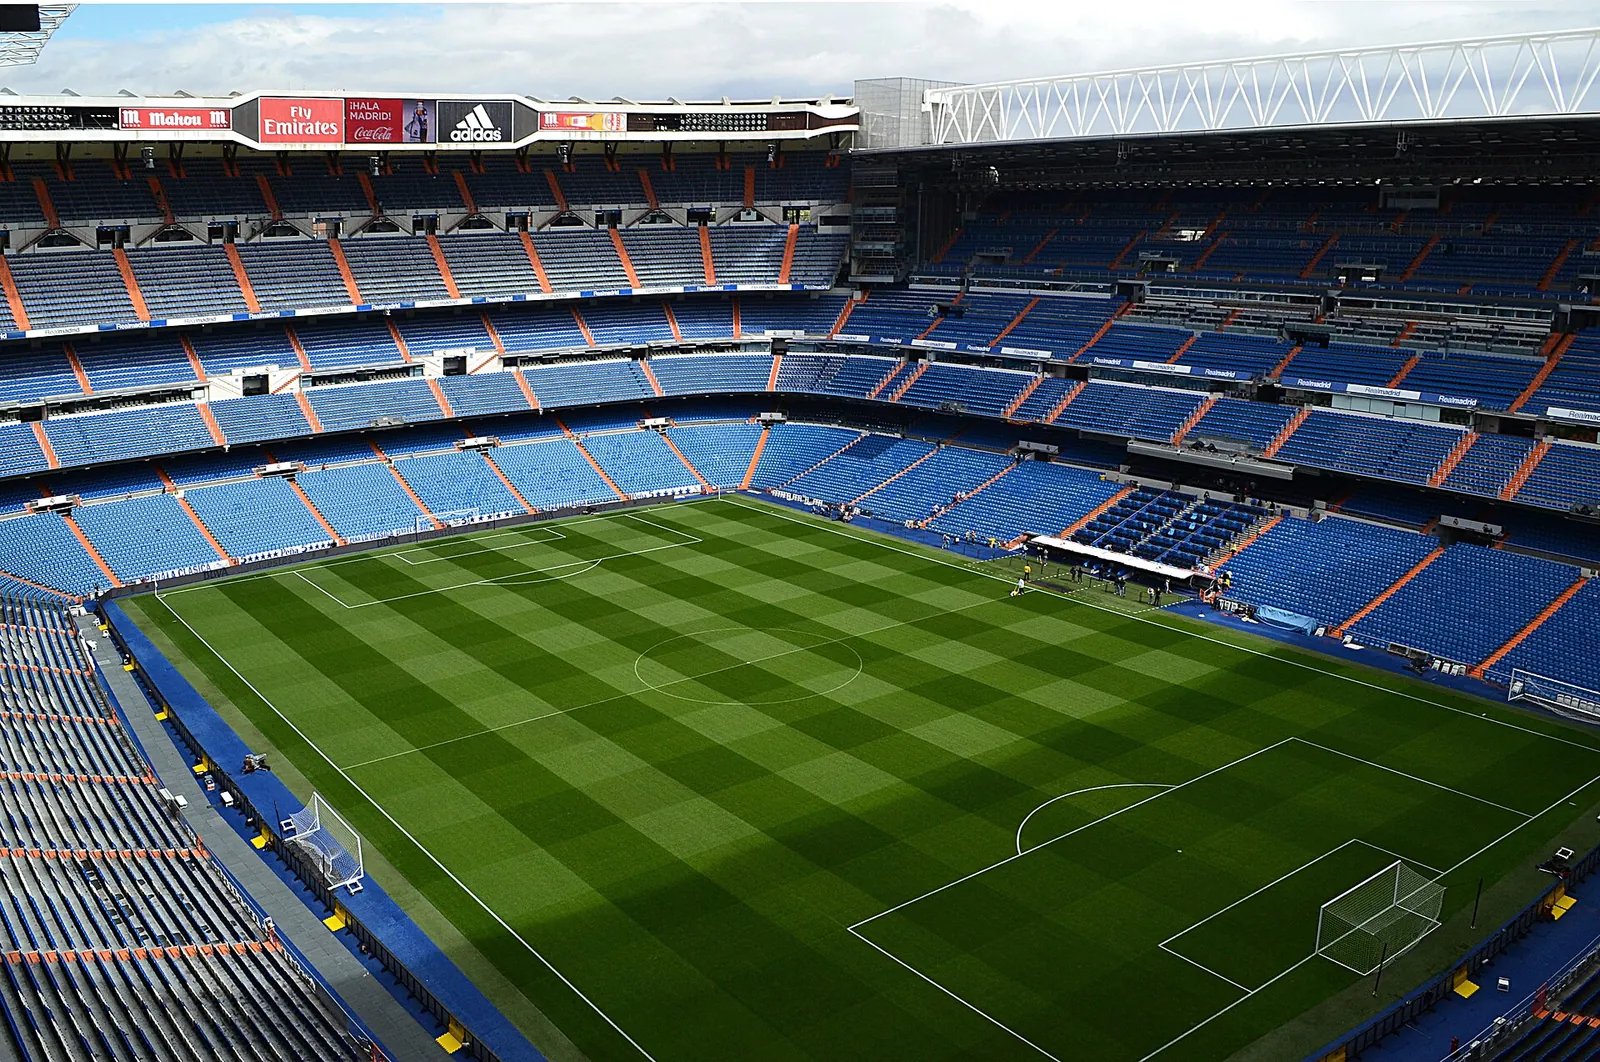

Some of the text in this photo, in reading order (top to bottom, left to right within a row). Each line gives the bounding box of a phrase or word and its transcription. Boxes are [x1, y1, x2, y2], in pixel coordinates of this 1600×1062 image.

[148, 111, 202, 126] Mahou
[290, 106, 312, 119] Fly
[350, 112, 392, 120] MADRID!
[264, 118, 338, 135] Emirates
[450, 127, 502, 141] adidas
